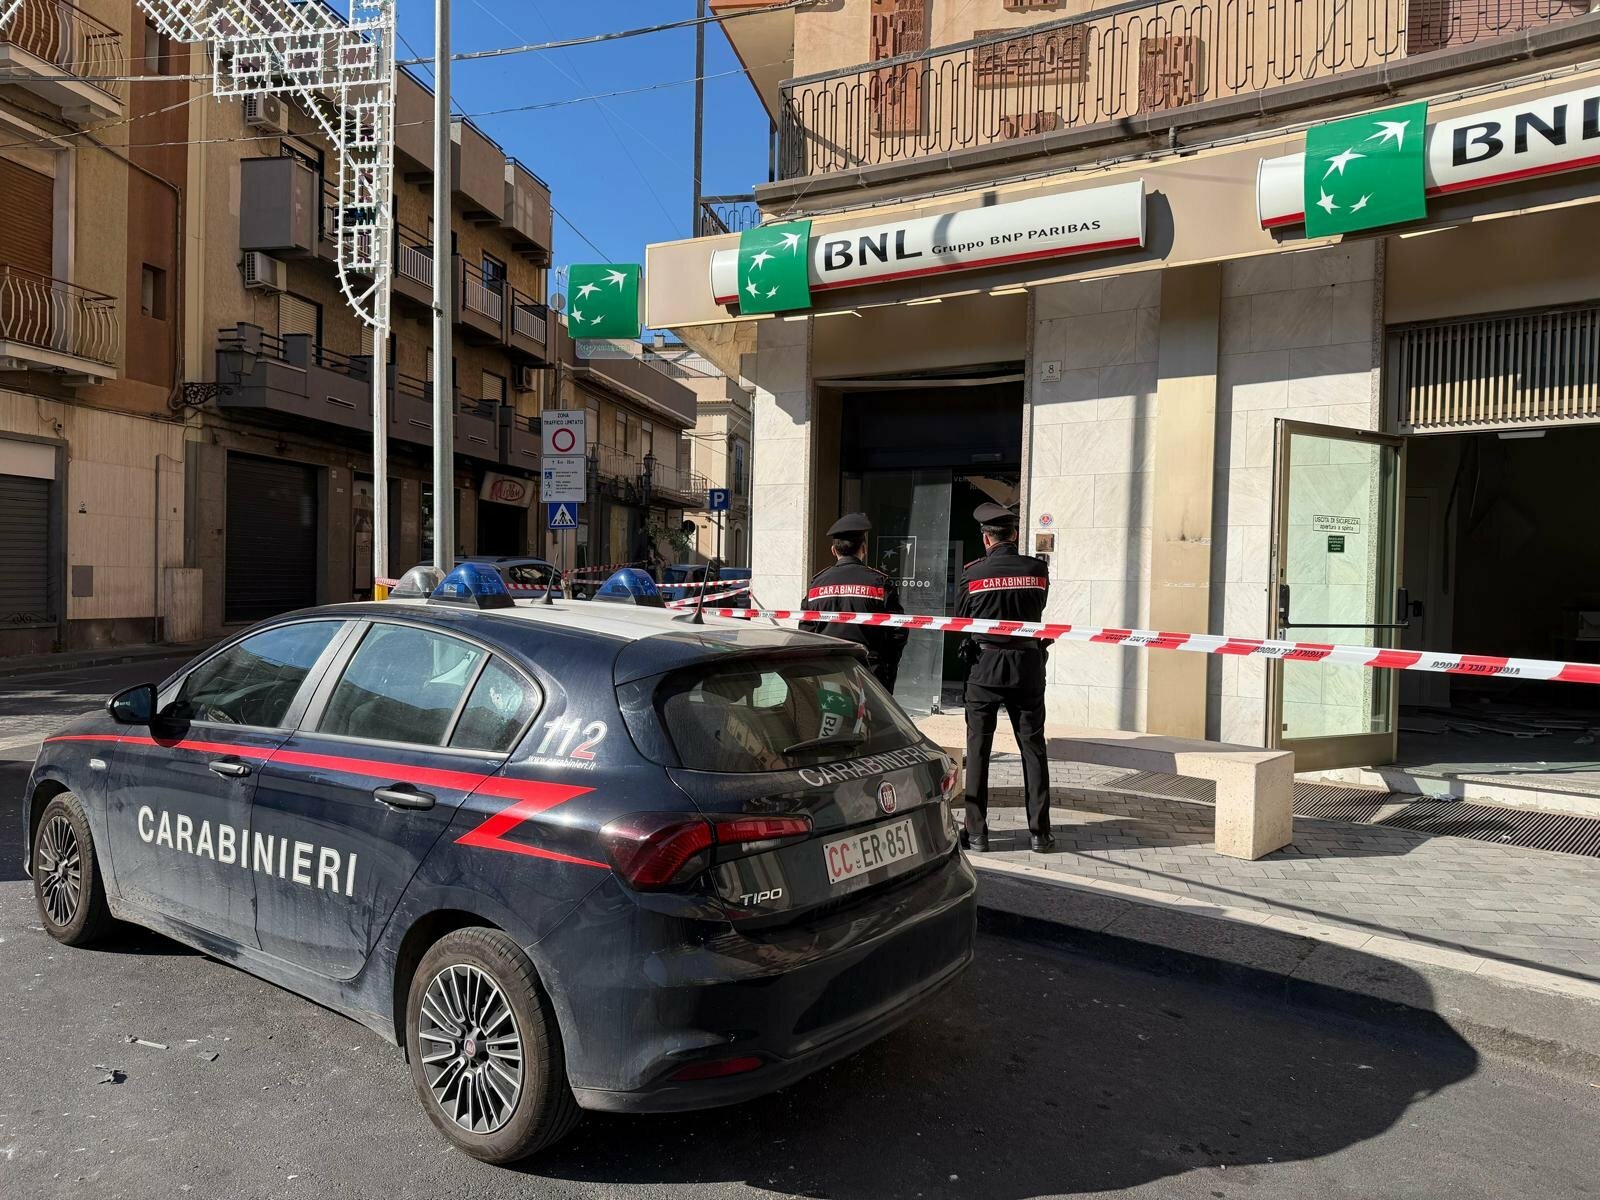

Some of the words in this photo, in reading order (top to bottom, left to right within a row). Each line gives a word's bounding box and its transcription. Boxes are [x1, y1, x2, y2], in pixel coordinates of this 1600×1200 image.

[824, 229, 922, 271] BNL
[931, 239, 984, 256] Gruppo
[990, 232, 1023, 245] BNP
[1028, 220, 1101, 239] PARIBAS
[1048, 364, 1054, 374] 8
[713, 491, 724, 507] P
[818, 586, 870, 596] CARABINIERI
[982, 577, 1039, 588] CARABINIERI
[537, 716, 608, 760] 112
[528, 755, 596, 770] www.carabinieri.it
[798, 744, 930, 786] CARABINIERI
[138, 805, 358, 897] CARABINIERI
[828, 843, 853, 878] CC
[860, 834, 883, 868] ER
[886, 824, 914, 858] 851
[740, 888, 782, 906] TIPO
